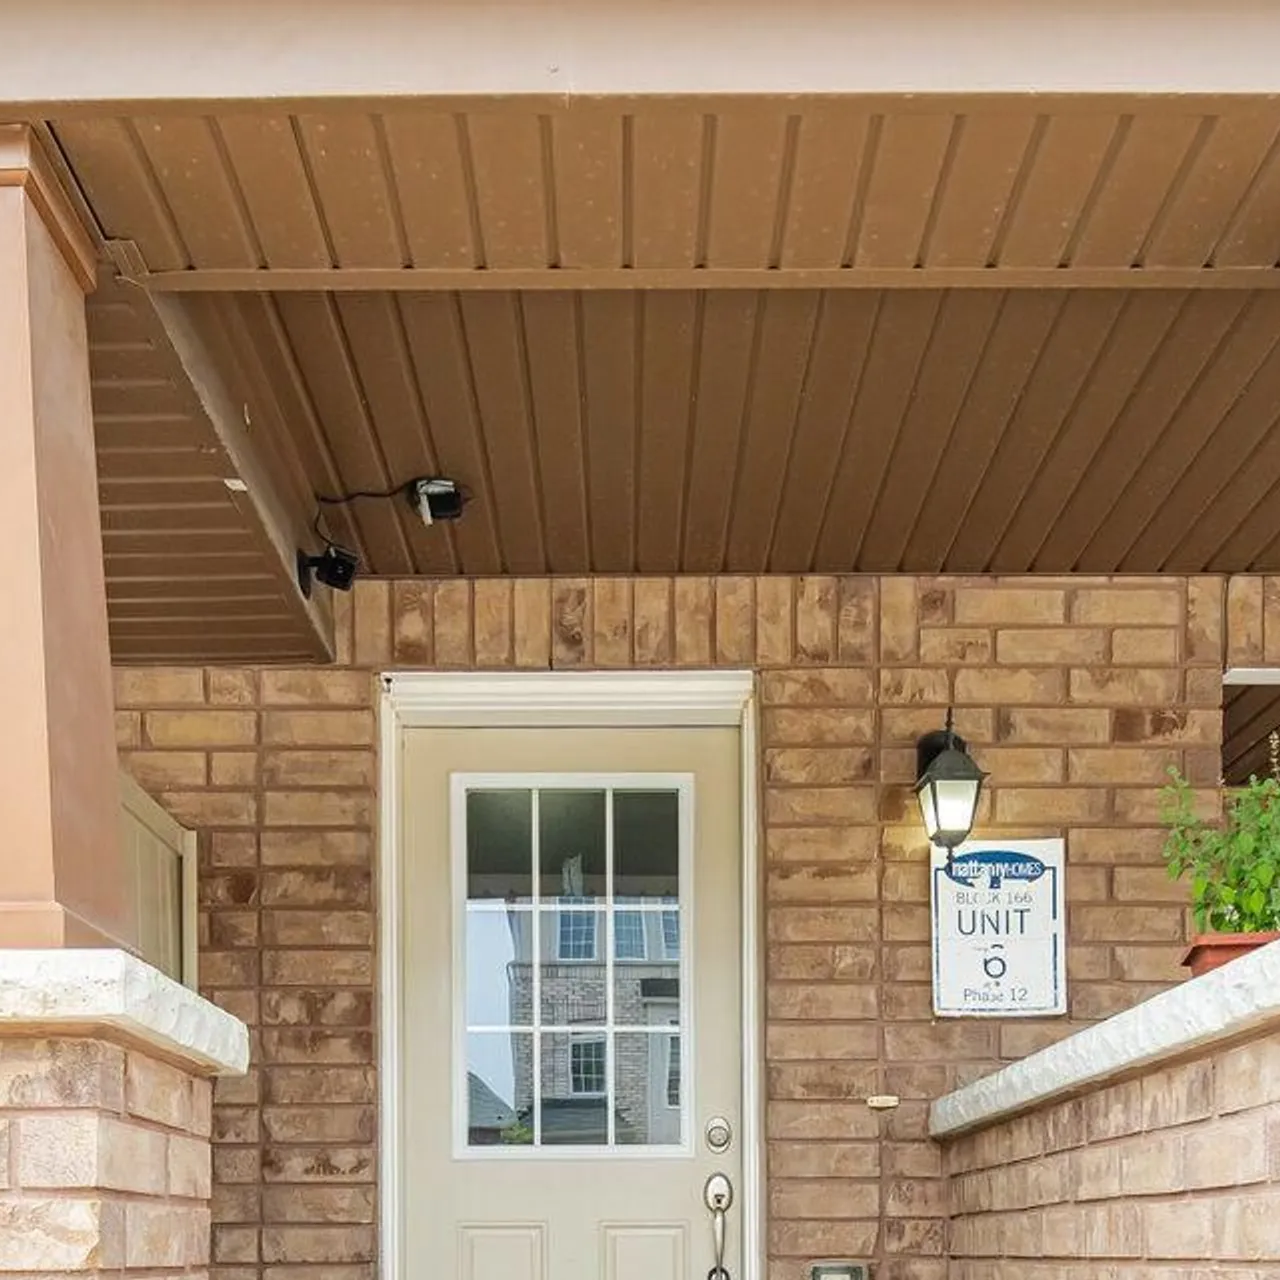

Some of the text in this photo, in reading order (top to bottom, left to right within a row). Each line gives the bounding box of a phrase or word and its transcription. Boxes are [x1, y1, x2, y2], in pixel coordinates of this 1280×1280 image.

[957, 909, 1031, 936] UNIT
[963, 988, 1028, 1002] Phase 12
